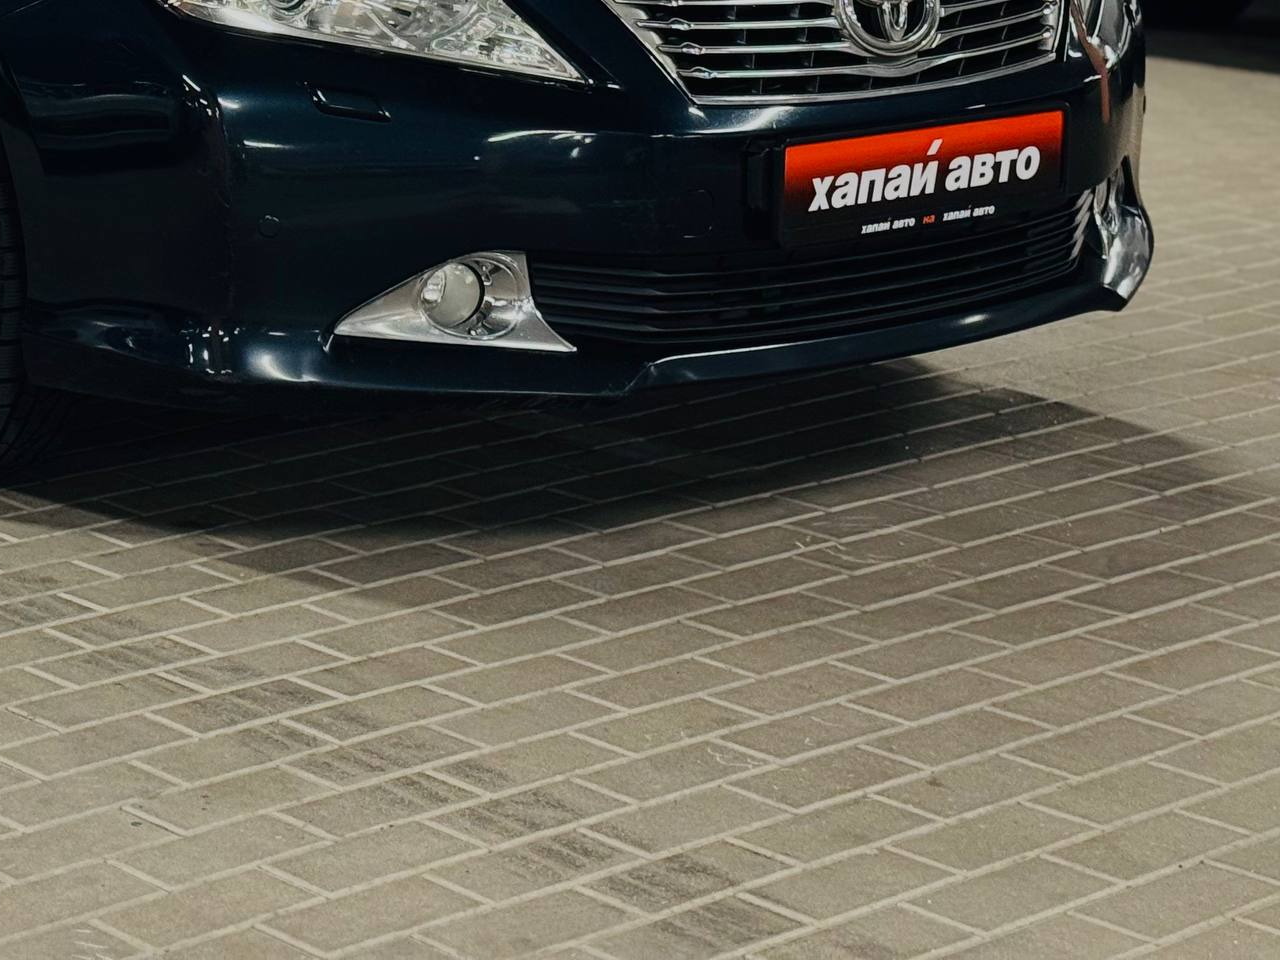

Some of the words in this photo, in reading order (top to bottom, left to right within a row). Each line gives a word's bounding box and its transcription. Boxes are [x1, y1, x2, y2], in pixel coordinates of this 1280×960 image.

[807, 138, 943, 212] хапай
[945, 145, 1041, 192] авто
[892, 218, 916, 230] авто
[973, 205, 996, 217] авто
